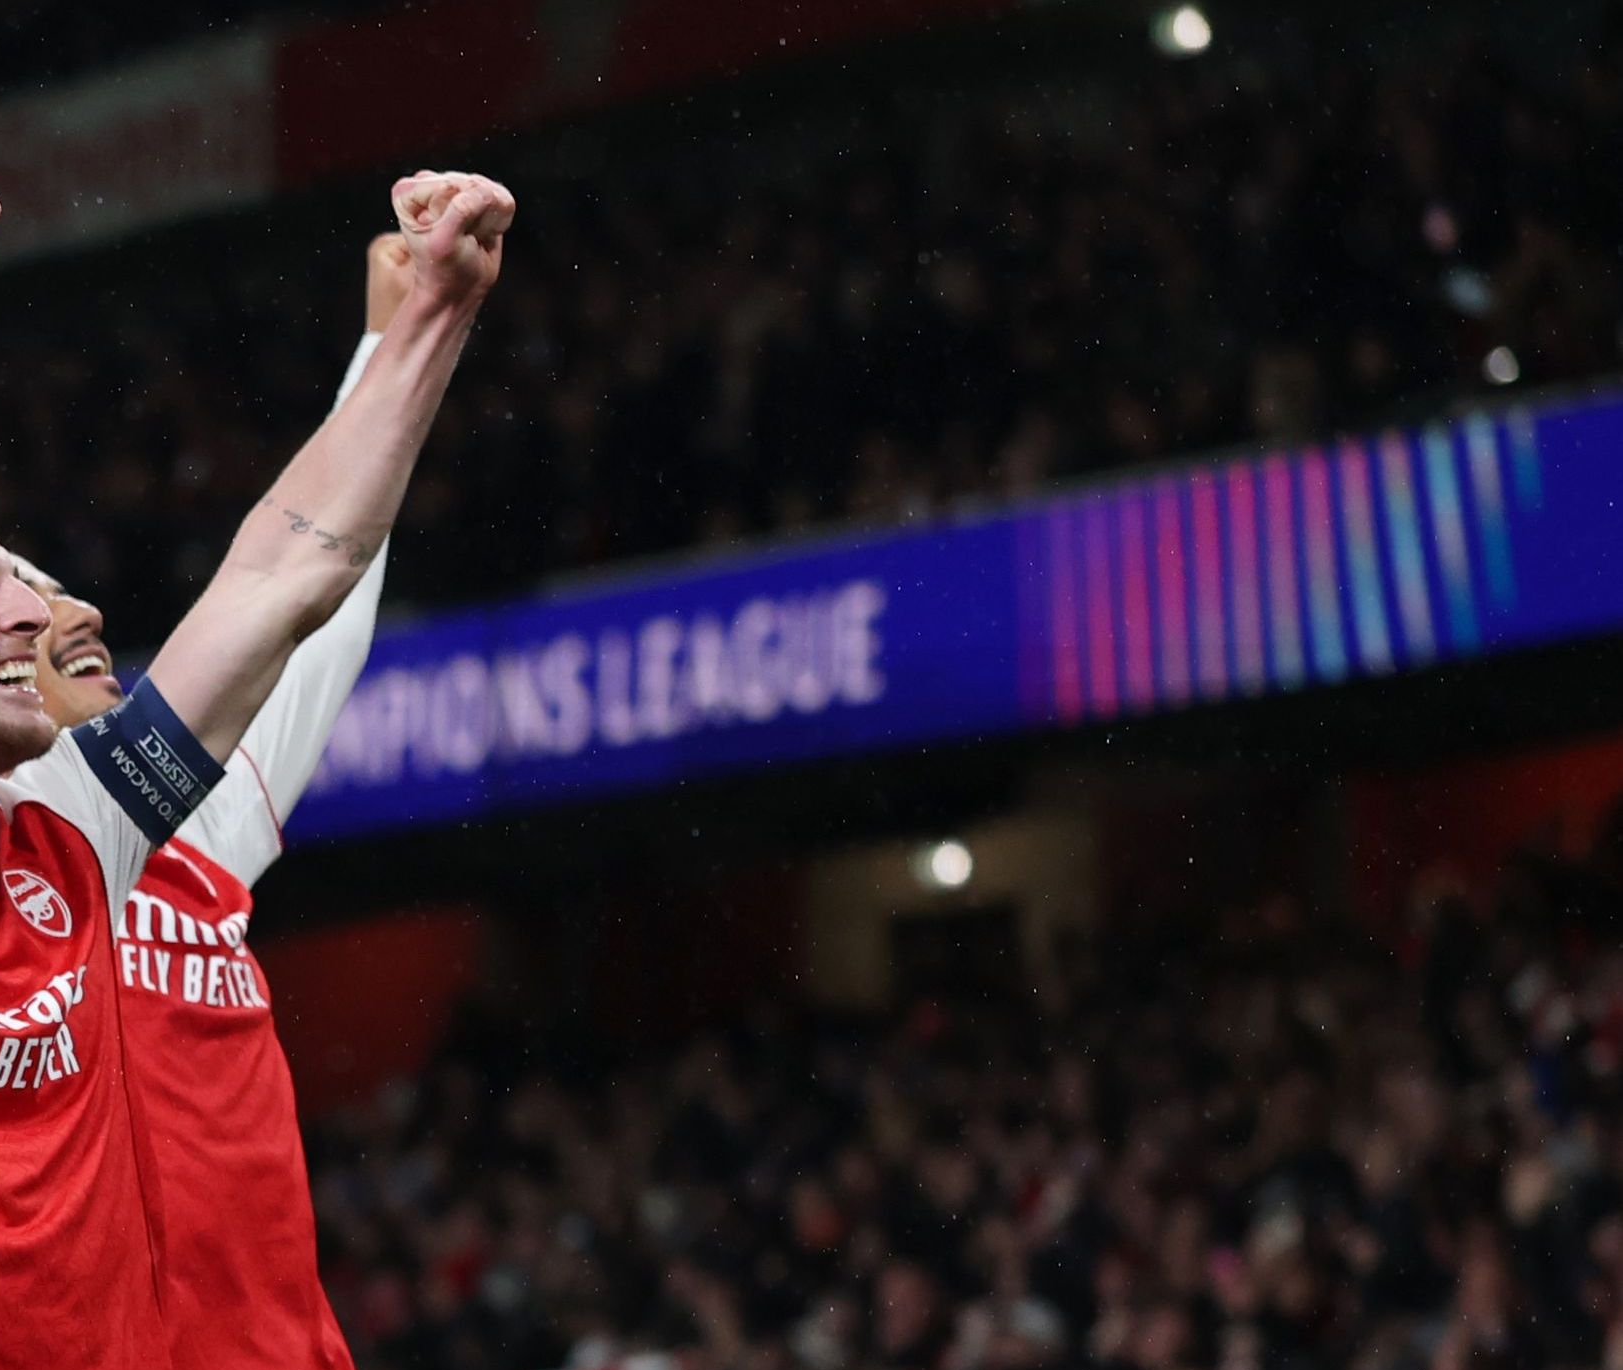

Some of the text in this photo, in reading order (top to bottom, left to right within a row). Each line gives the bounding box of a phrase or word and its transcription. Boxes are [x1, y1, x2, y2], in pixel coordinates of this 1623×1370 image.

[599, 578, 887, 746] LEAGUE
[110, 744, 163, 807] RACISM
[137, 733, 195, 797] RESPECT
[120, 942, 172, 996] FLY
